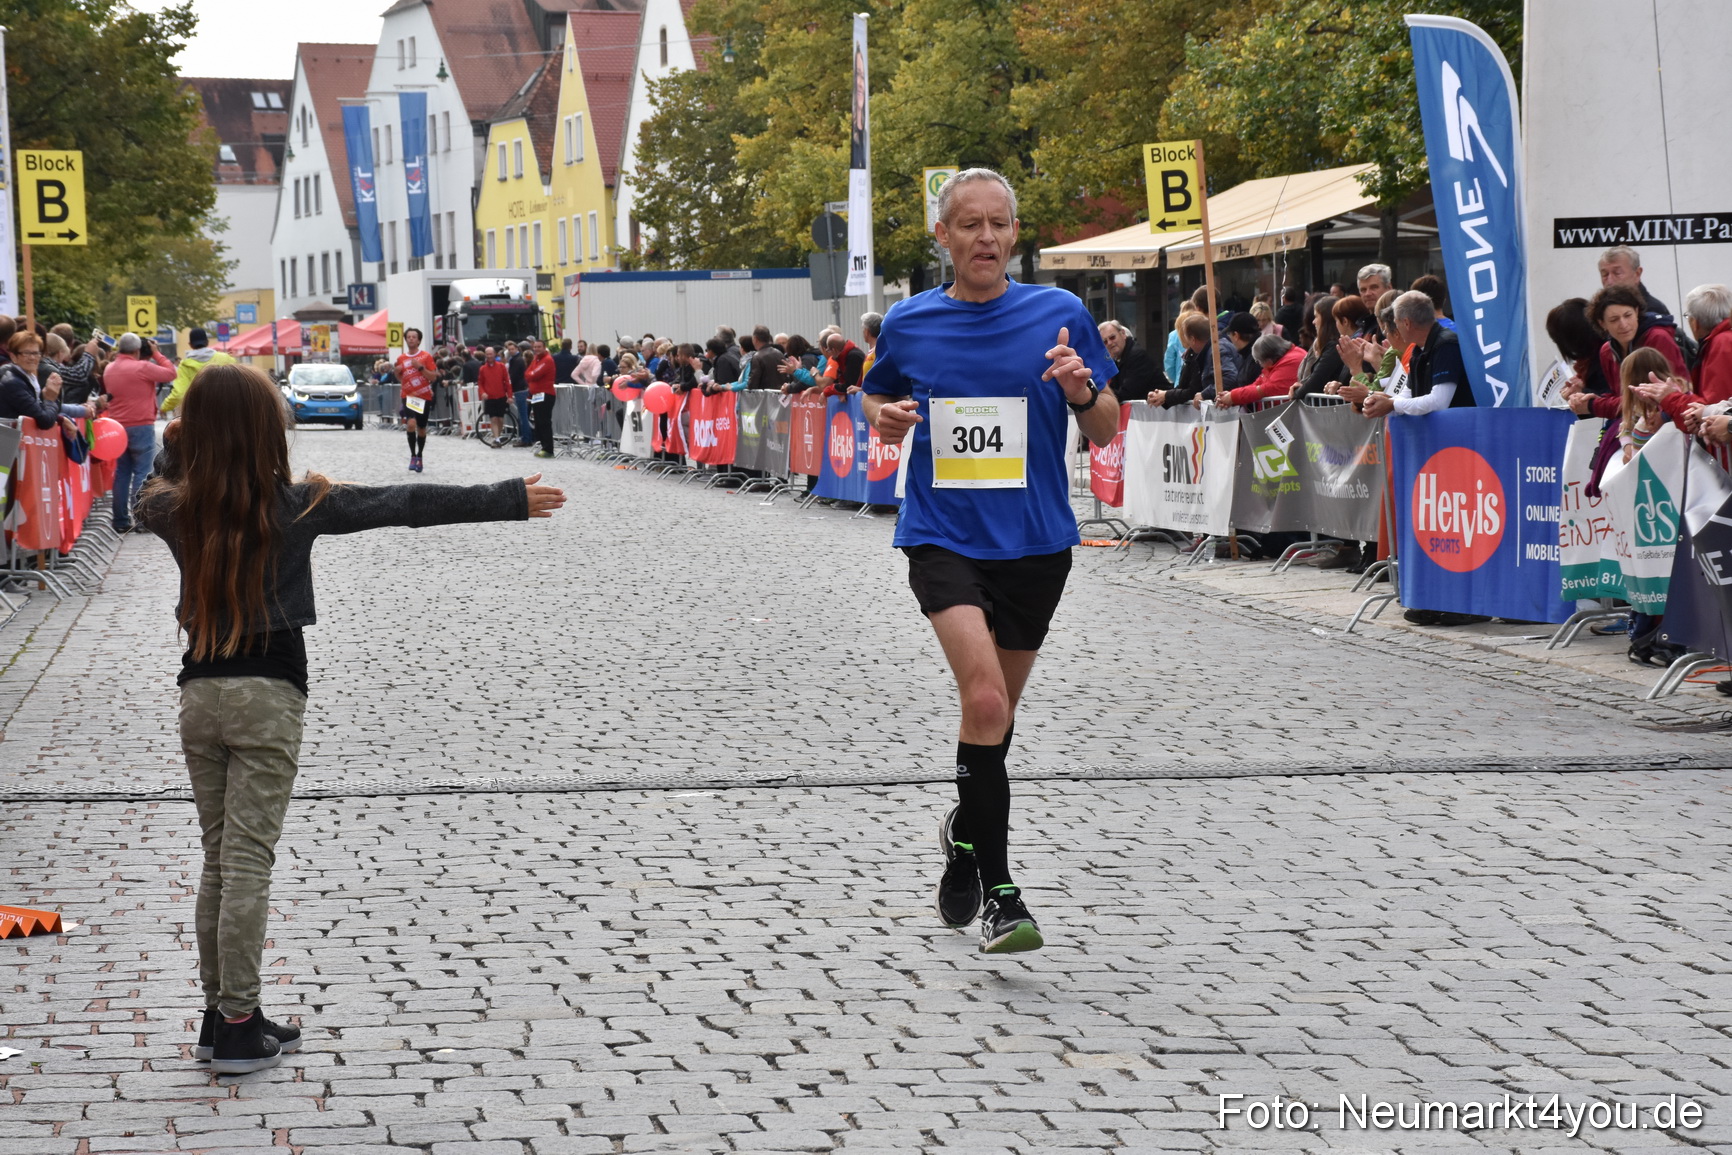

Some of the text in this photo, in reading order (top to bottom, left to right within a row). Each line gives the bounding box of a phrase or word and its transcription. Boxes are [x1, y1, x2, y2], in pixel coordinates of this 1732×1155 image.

[25, 154, 76, 171] Block
[1150, 144, 1197, 164] Block
[36, 179, 69, 223] B
[1161, 169, 1192, 214] B
[508, 200, 526, 219] HOTEL
[1558, 217, 1732, 245] www.MINI-Pa
[130, 297, 152, 306] Block
[135, 308, 149, 328] C
[390, 329, 400, 342] D
[1541, 378, 1554, 401] swn
[964, 405, 999, 415] BOCK
[952, 425, 1004, 453] 304
[1525, 466, 1556, 483] STORE
[1418, 473, 1500, 548] Hervis
[1525, 504, 1560, 522] ONLINE
[1429, 537, 1460, 554] SPORTS
[1525, 543, 1560, 561] MOBILE
